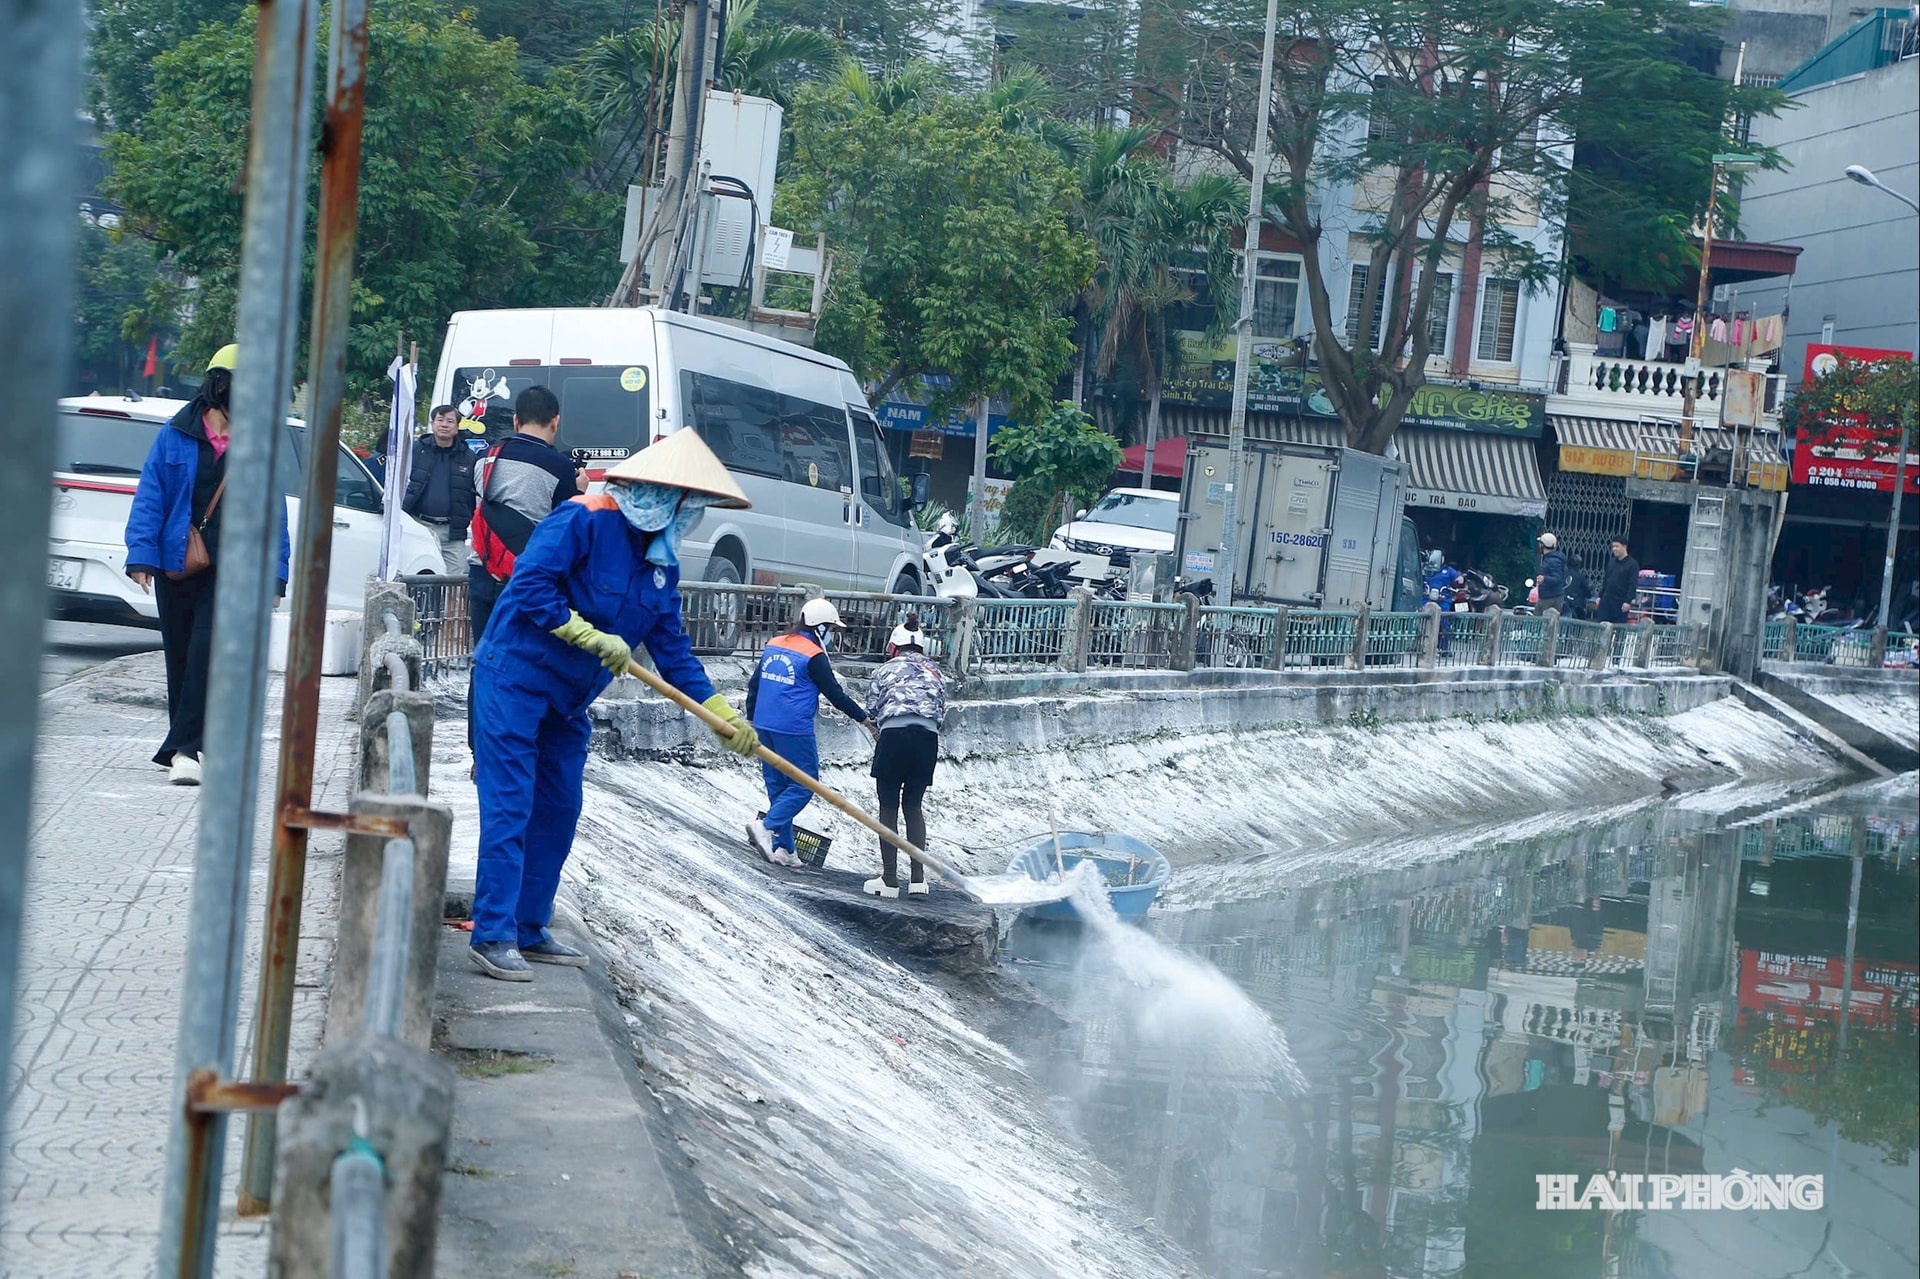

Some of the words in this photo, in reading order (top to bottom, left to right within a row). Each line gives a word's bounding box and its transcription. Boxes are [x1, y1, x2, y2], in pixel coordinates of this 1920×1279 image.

[1162, 389, 1180, 400] Sinh
[887, 407, 921, 421] NAM
[1271, 531, 1324, 548] 15C-28620
[48, 573, 73, 588] 0.24
